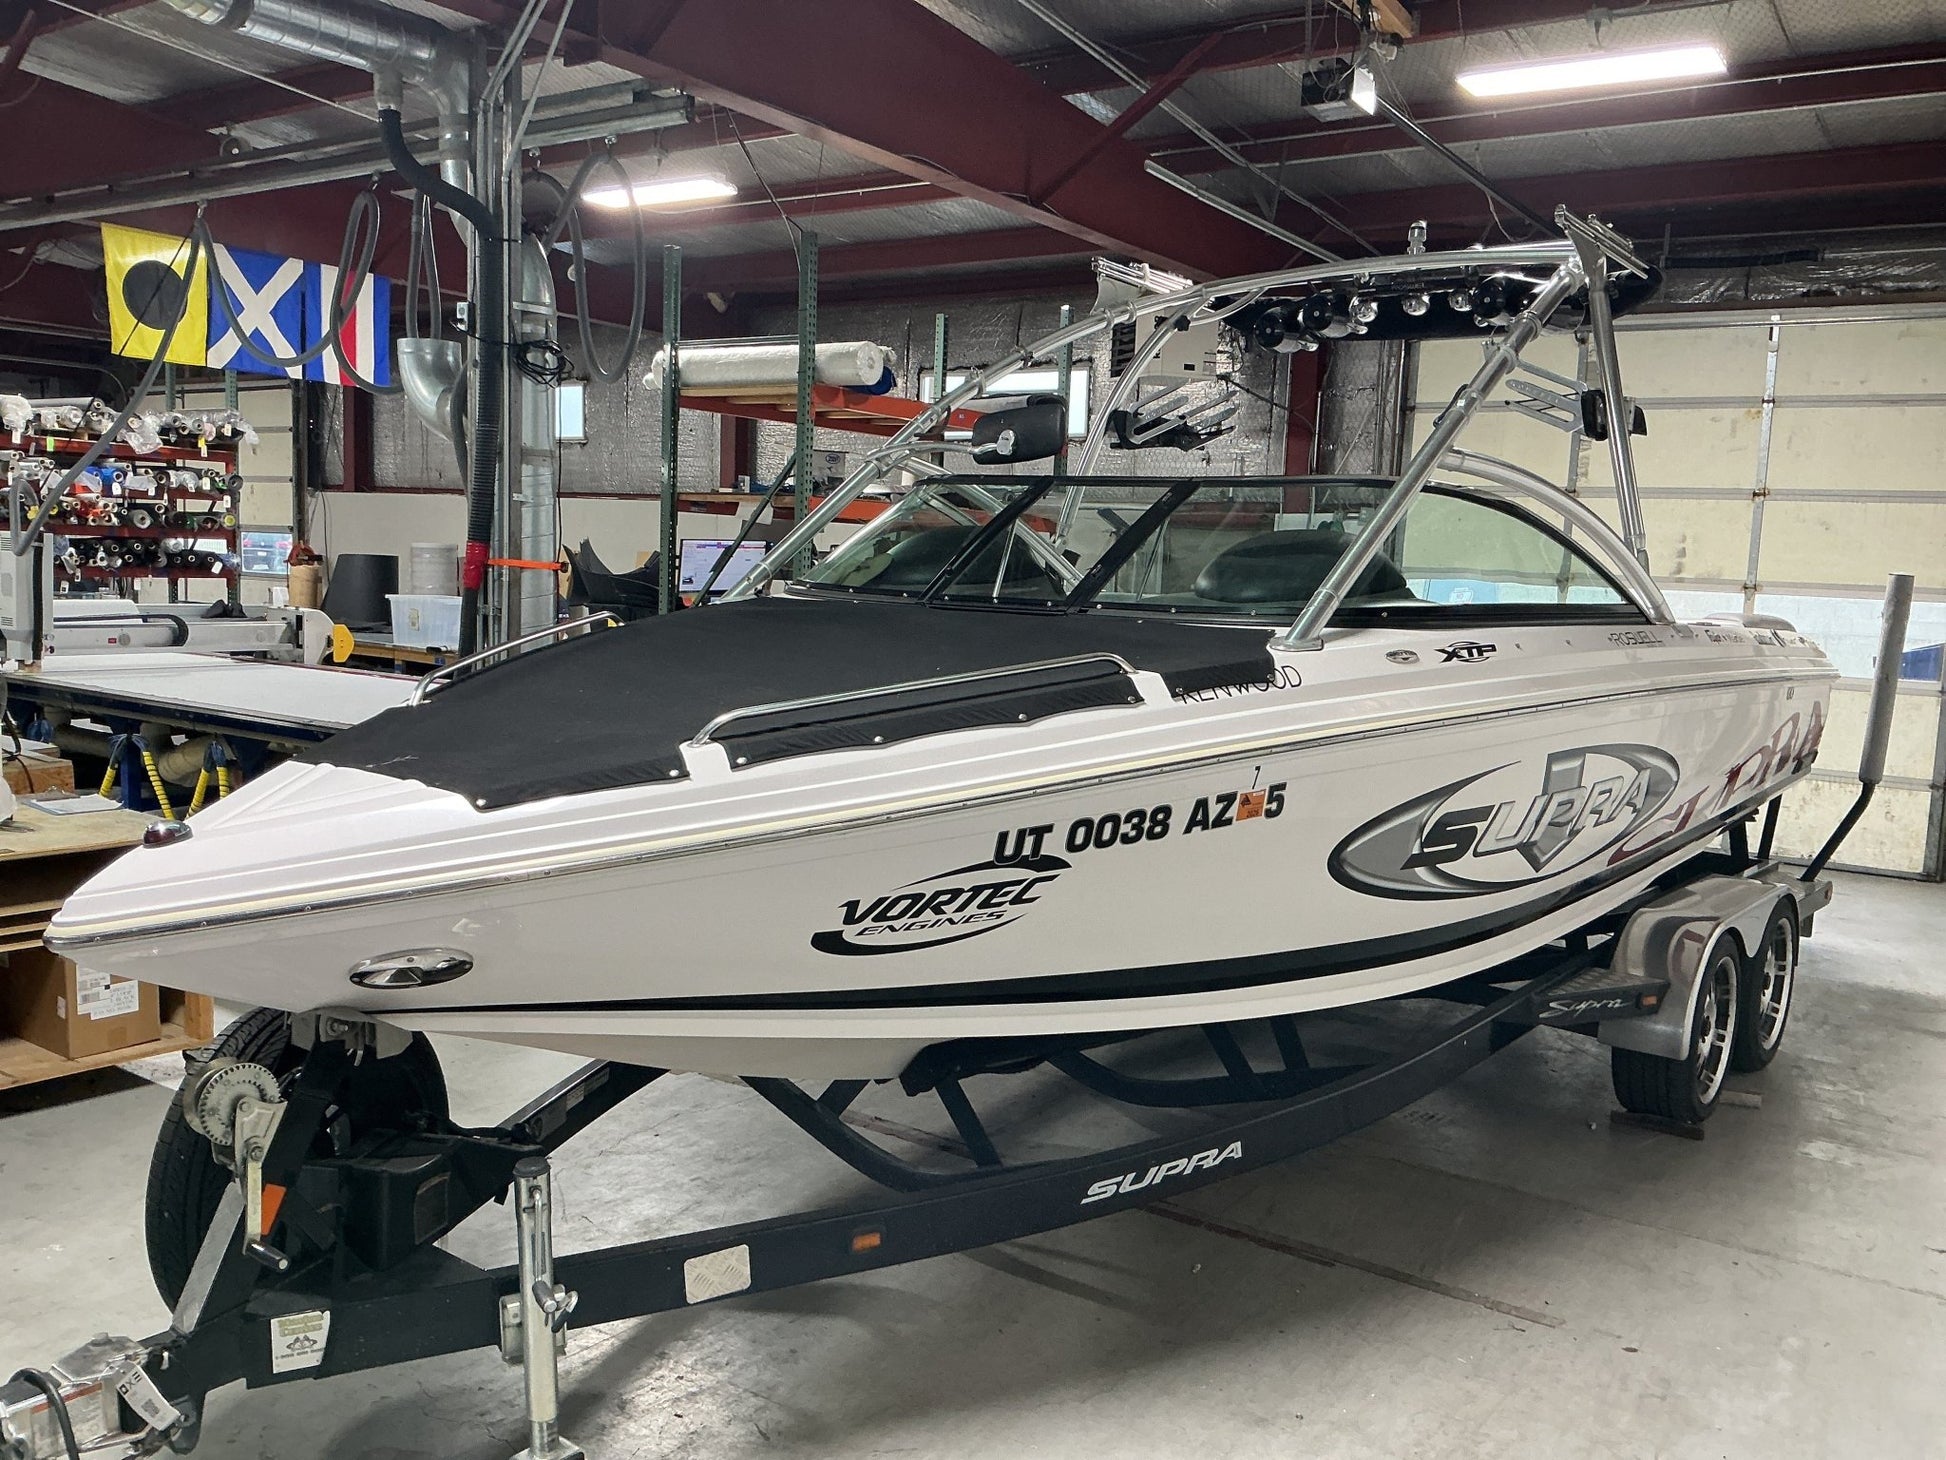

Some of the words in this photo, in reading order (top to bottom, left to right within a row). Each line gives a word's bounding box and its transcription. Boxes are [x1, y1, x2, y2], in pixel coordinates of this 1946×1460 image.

[1434, 642, 1497, 663] XTP
[993, 823, 1055, 865] UT
[1065, 804, 1173, 854] 0038
[1400, 767, 1652, 870] SUPRA
[838, 873, 1061, 926] VORTEC
[854, 910, 1007, 937] ENGINES
[1080, 1140, 1243, 1205] SUPRA
